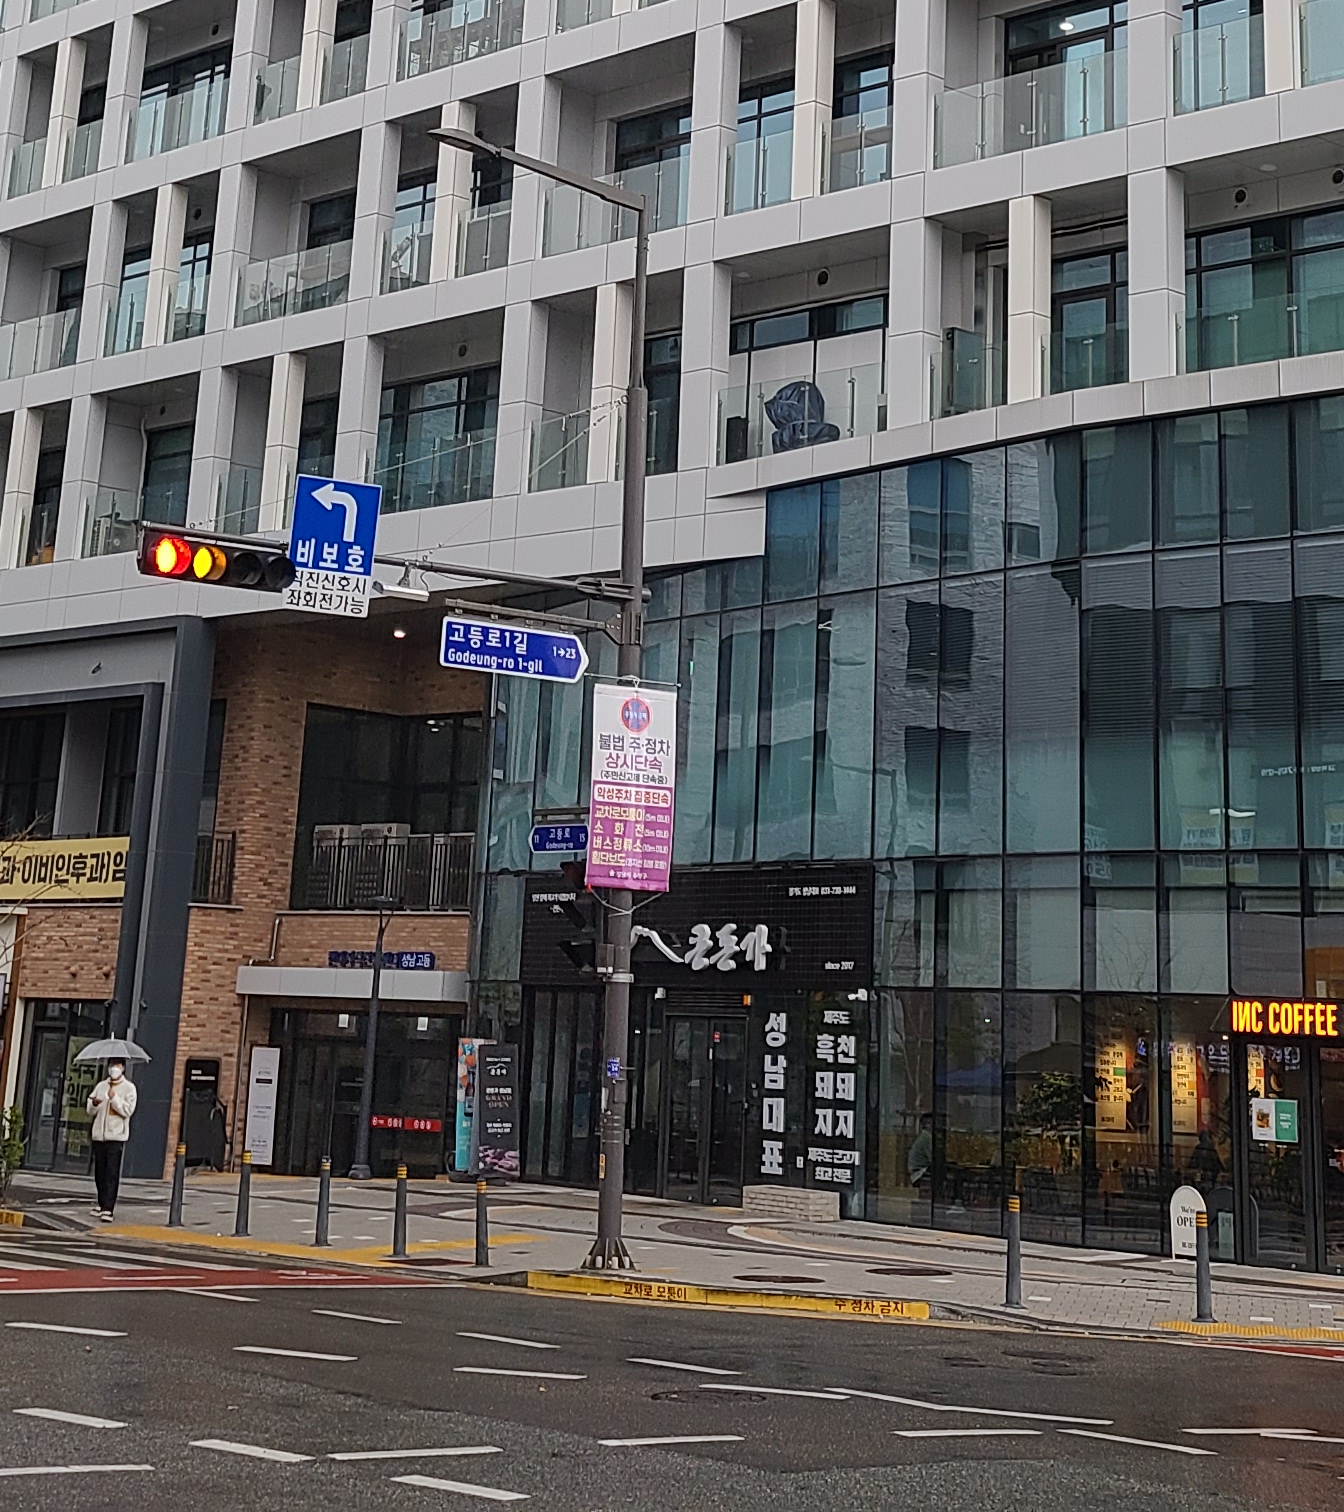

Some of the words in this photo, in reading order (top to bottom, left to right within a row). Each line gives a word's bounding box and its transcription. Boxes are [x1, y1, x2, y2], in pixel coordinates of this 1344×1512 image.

[296, 538, 365, 573] 비보호
[294, 569, 367, 595] 직진신호시
[286, 589, 364, 615] 좌회전가능
[448, 624, 528, 655] 고등로1길
[447, 648, 515, 669] Godeung-ro
[518, 657, 543, 674] 1-gil
[599, 733, 625, 752] 불법
[605, 752, 663, 774] 상시단속
[597, 787, 633, 802] 악성주차
[634, 790, 669, 805] 집중단속
[1268, 1002, 1340, 1037] COFFEE
[760, 1012, 787, 1176] 성남대표
[1176, 1215, 1197, 1227] OPE
[623, 1282, 653, 1297] 교차로
[879, 1300, 904, 1315] 금지
